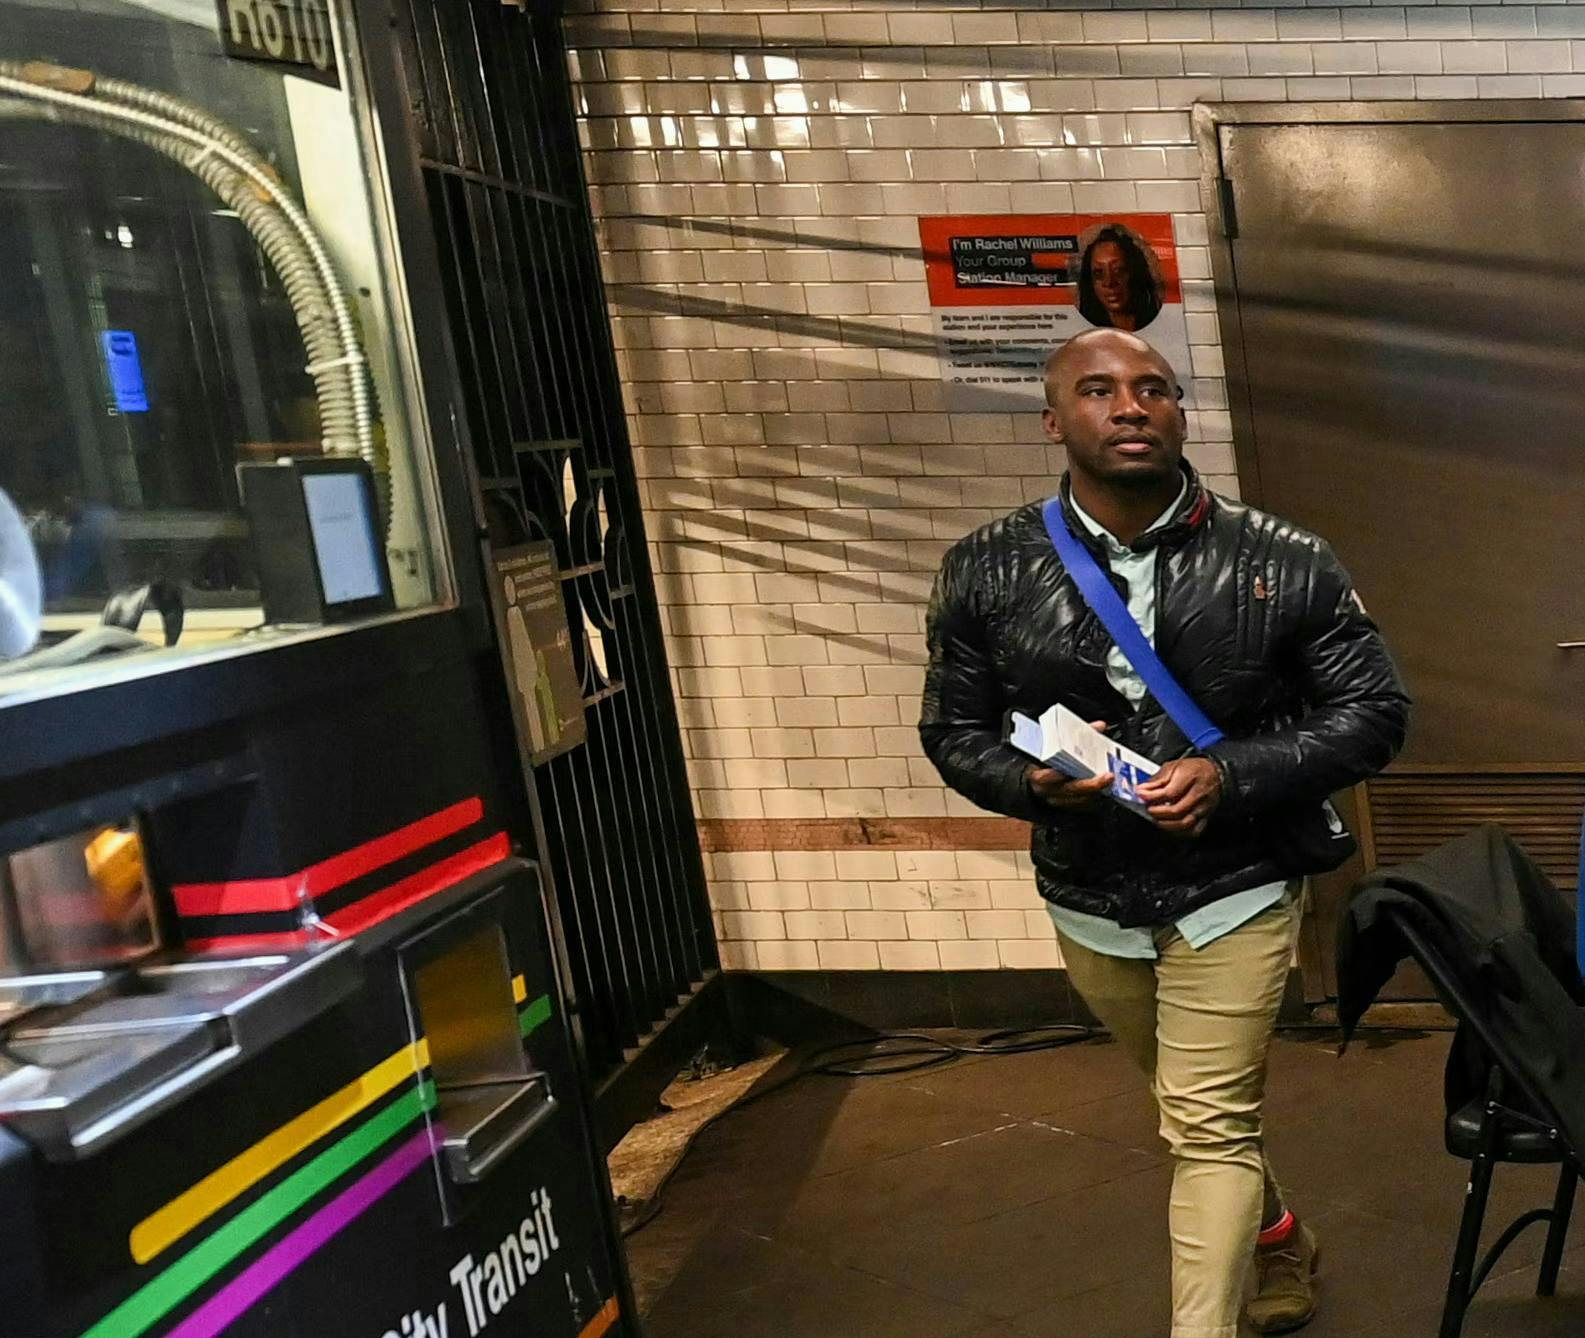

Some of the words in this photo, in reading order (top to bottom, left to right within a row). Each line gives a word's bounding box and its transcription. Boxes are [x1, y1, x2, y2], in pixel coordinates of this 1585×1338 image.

[952, 238, 972, 250] I'm
[975, 238, 1018, 250] Rachel
[1019, 237, 1074, 250] Williams
[956, 256, 984, 268] Your
[987, 255, 1027, 268] Group
[957, 272, 1001, 285] Station
[1005, 271, 1058, 284] Manager
[449, 1186, 560, 1338] Transit
